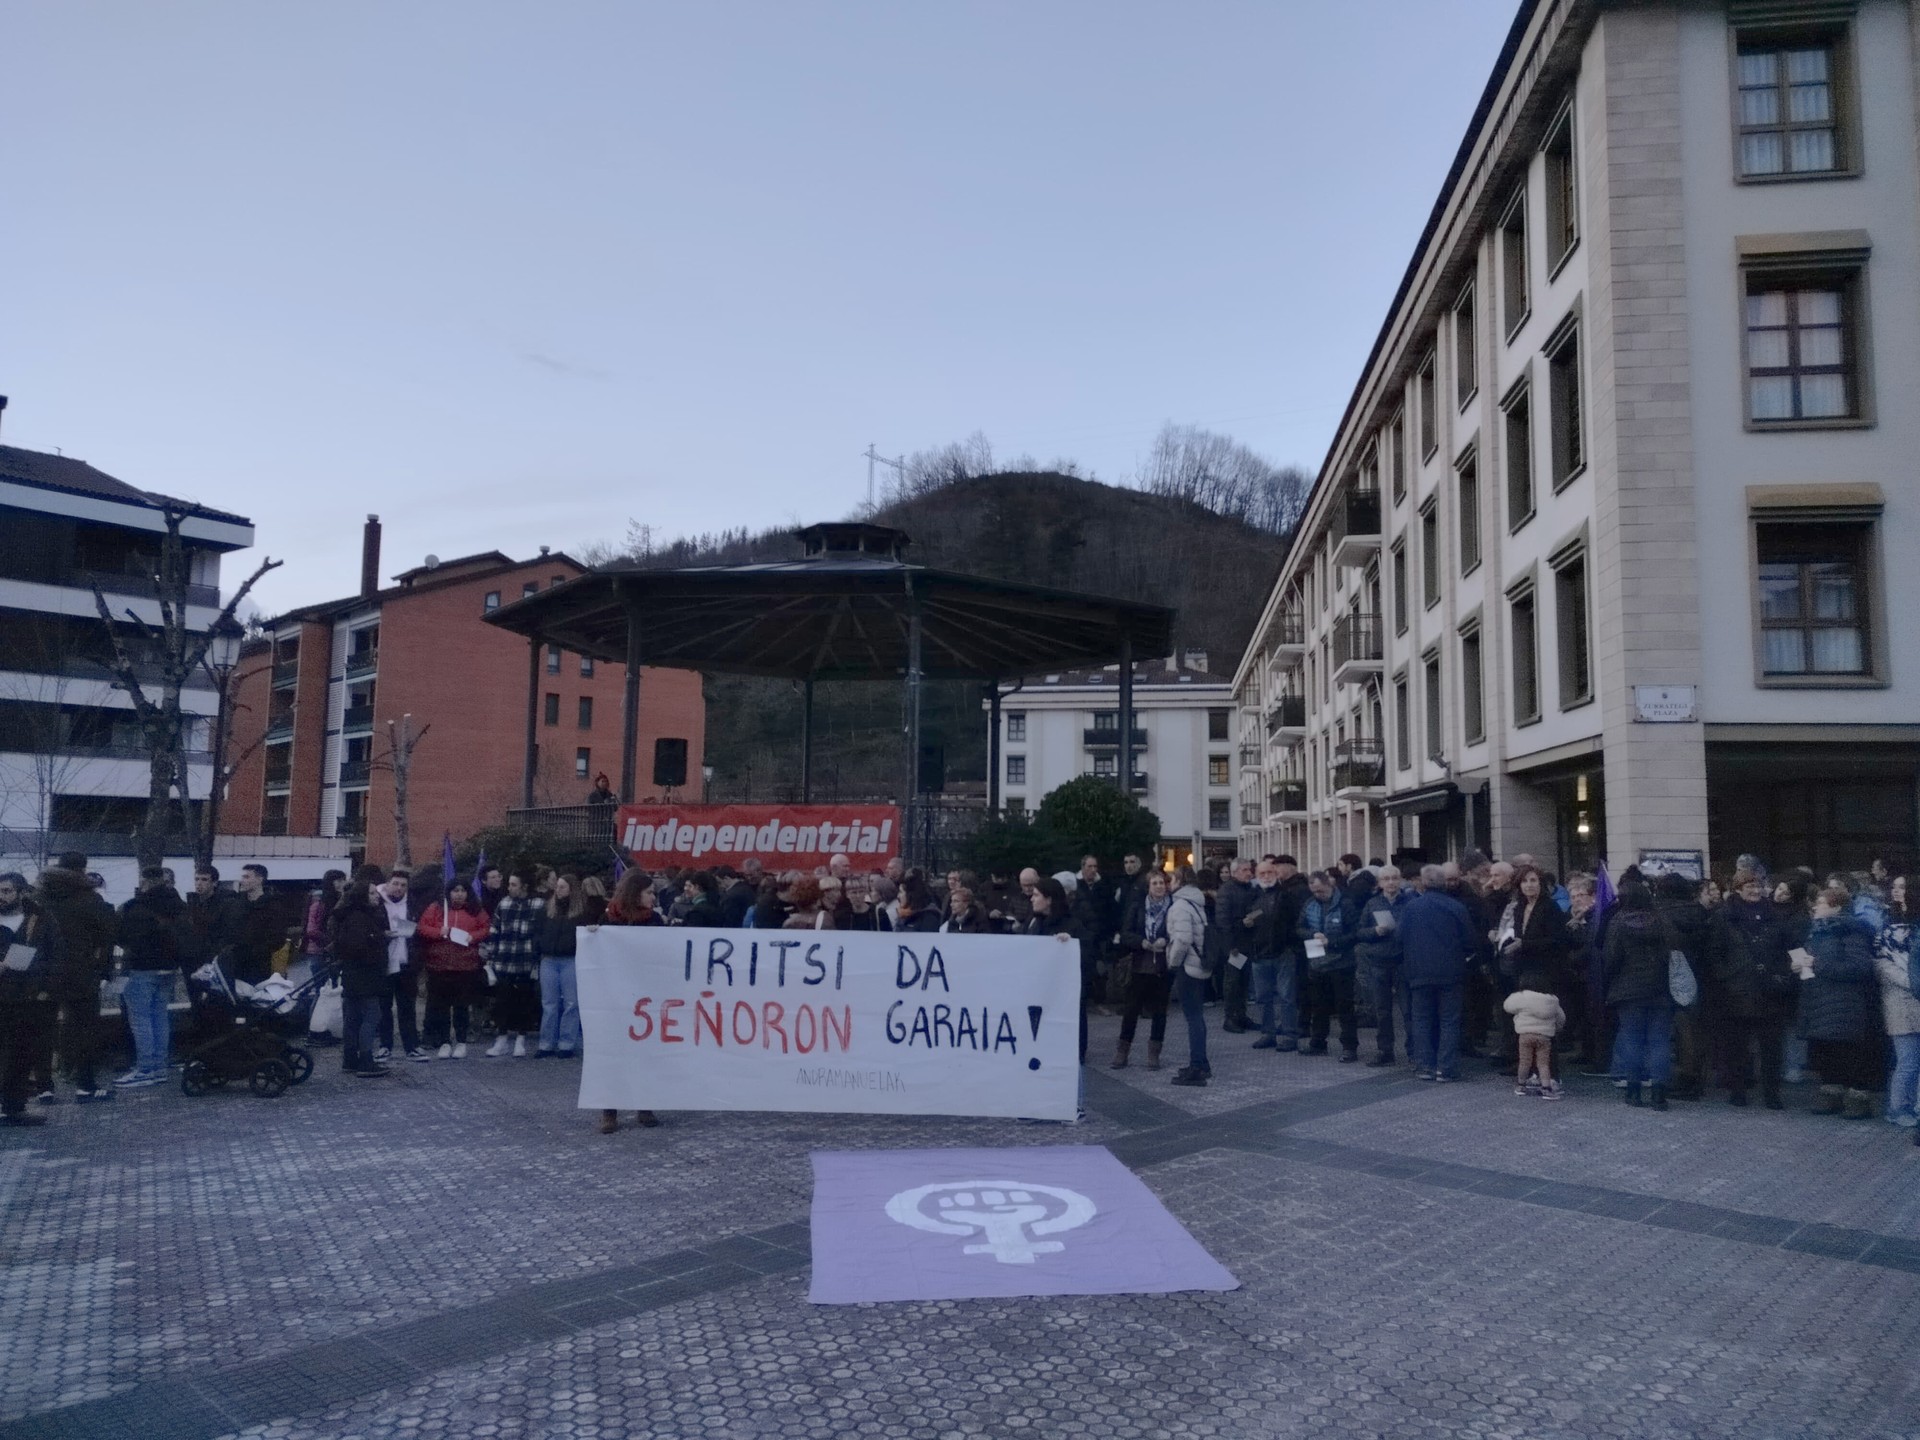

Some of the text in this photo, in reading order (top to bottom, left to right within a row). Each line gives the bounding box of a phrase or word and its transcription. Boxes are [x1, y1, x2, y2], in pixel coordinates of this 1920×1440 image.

[622, 817, 893, 857] independentzia!
[684, 938, 950, 993] IRITSI DA
[628, 990, 851, 1054] SEÑORON
